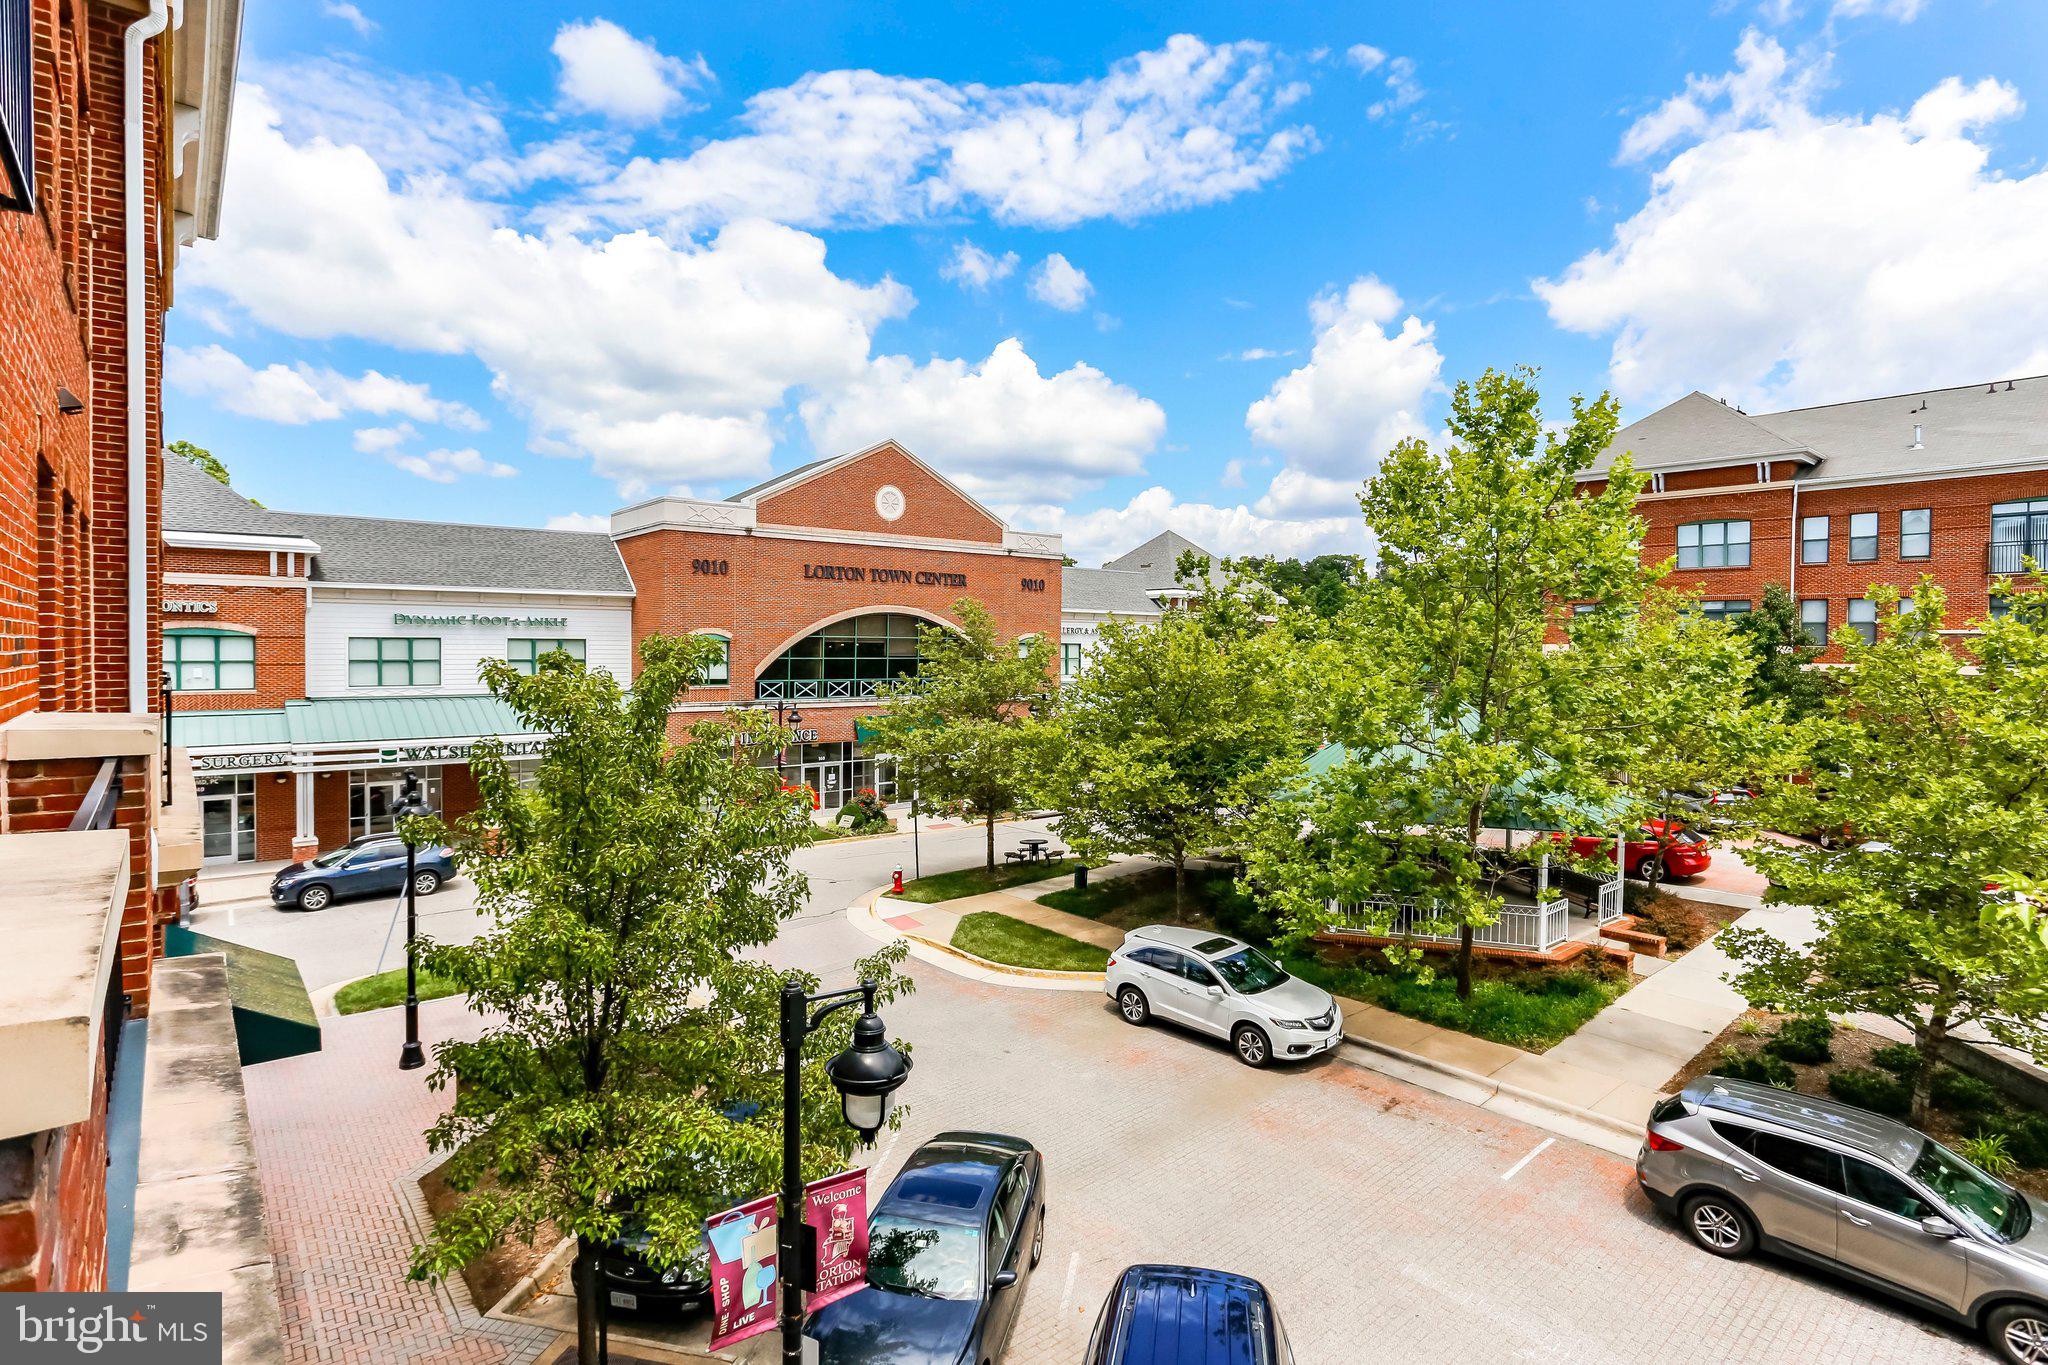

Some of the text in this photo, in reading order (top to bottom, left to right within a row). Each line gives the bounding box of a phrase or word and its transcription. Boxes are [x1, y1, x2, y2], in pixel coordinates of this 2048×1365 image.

[691, 559, 729, 575] 9010
[804, 564, 968, 587] LORTON TOWN CENTER
[1021, 578, 1045, 592] 9010
[394, 613, 467, 626] DYNAMIC
[471, 614, 511, 626] FOOT
[525, 616, 568, 627] ANKLE
[201, 753, 287, 769] SURGERY
[404, 745, 472, 762] WALSH
[812, 1185, 862, 1207] Welcome
[817, 1258, 862, 1282] ORTON
[817, 1267, 862, 1292] TATION
[719, 1277, 731, 1335] DINE SHOP
[733, 1312, 756, 1330] LIVE
